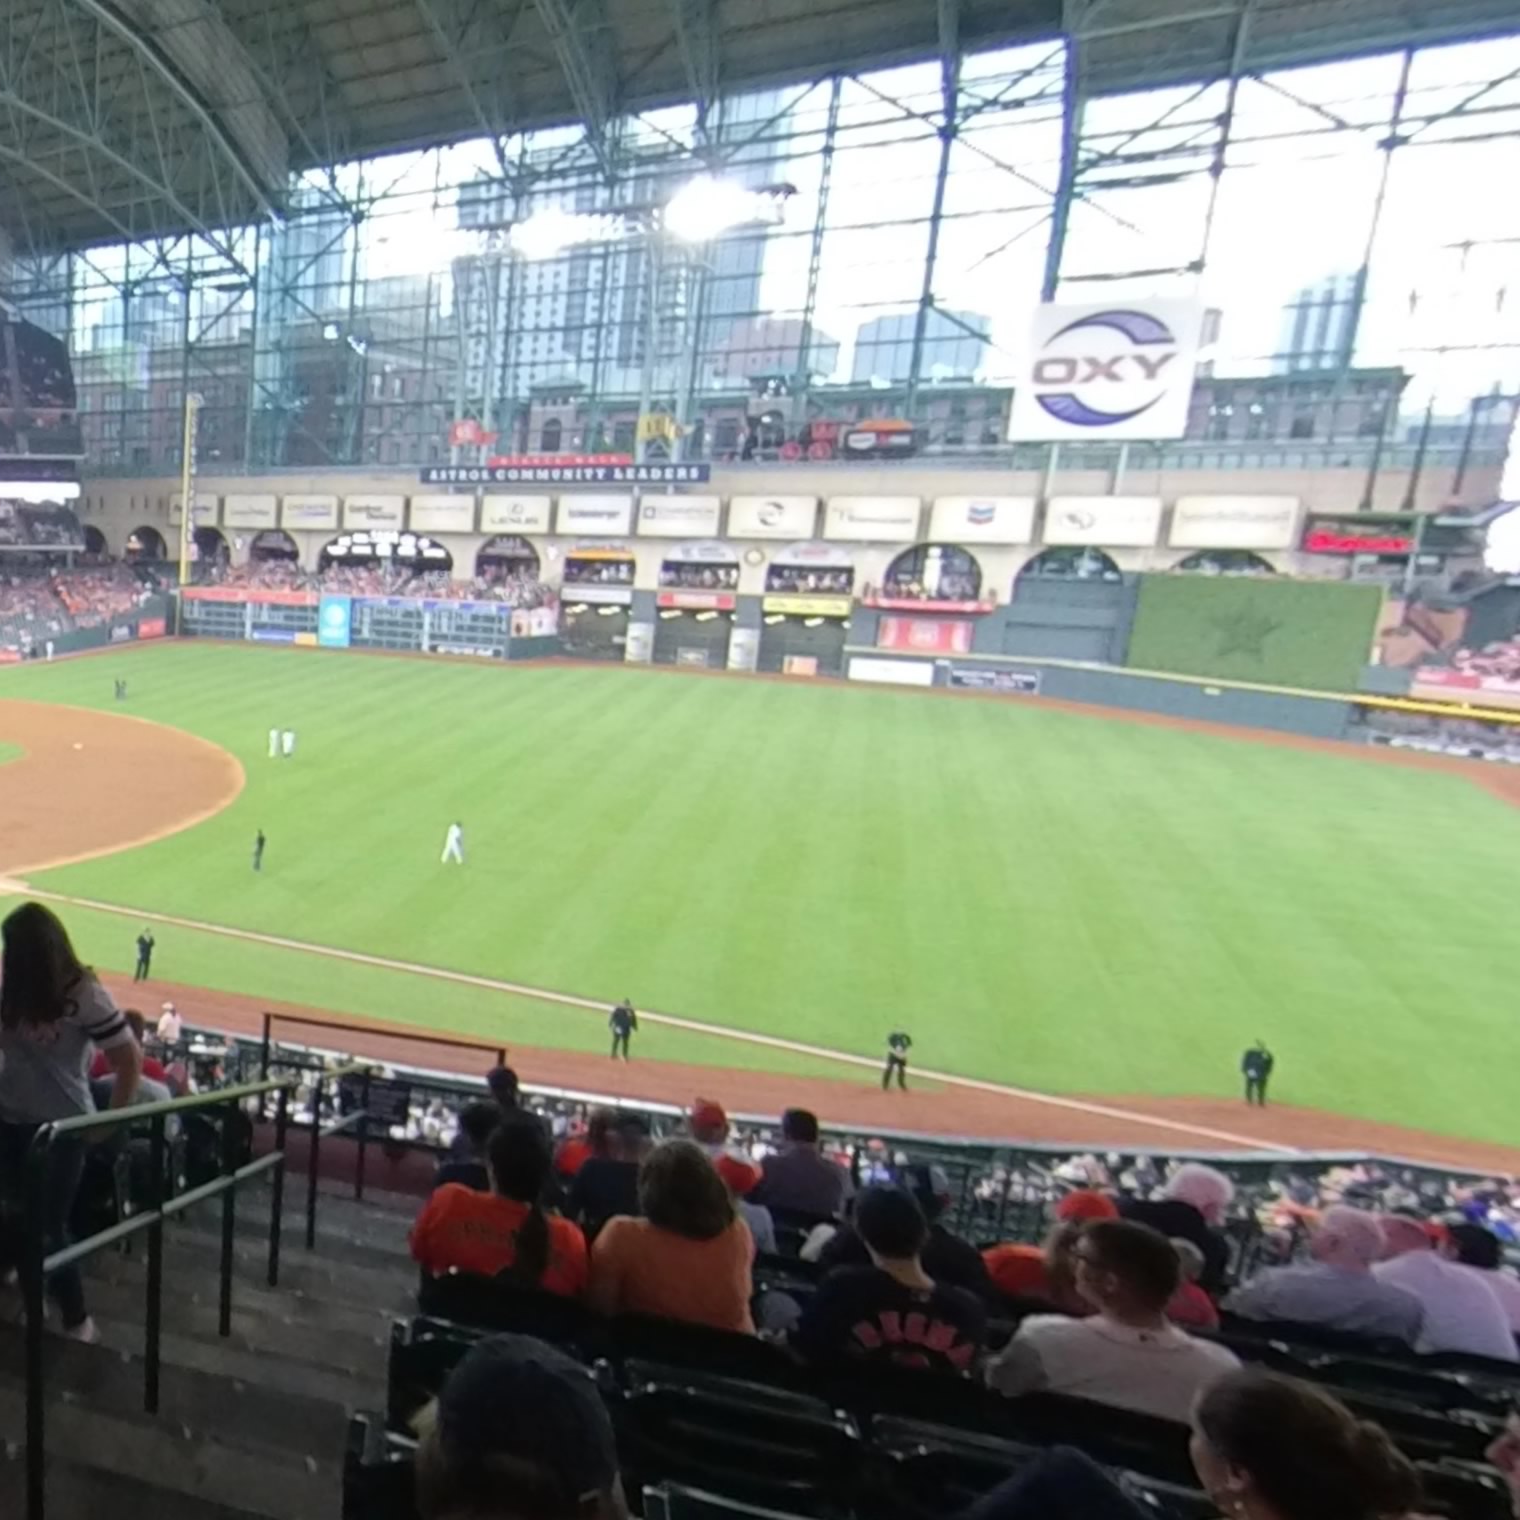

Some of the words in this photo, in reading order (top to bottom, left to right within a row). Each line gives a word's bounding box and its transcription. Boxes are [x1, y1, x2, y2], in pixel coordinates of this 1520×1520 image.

[1032, 351, 1178, 384] OXY
[495, 468, 606, 481] COMMUNITY
[613, 467, 698, 480] LEADERS
